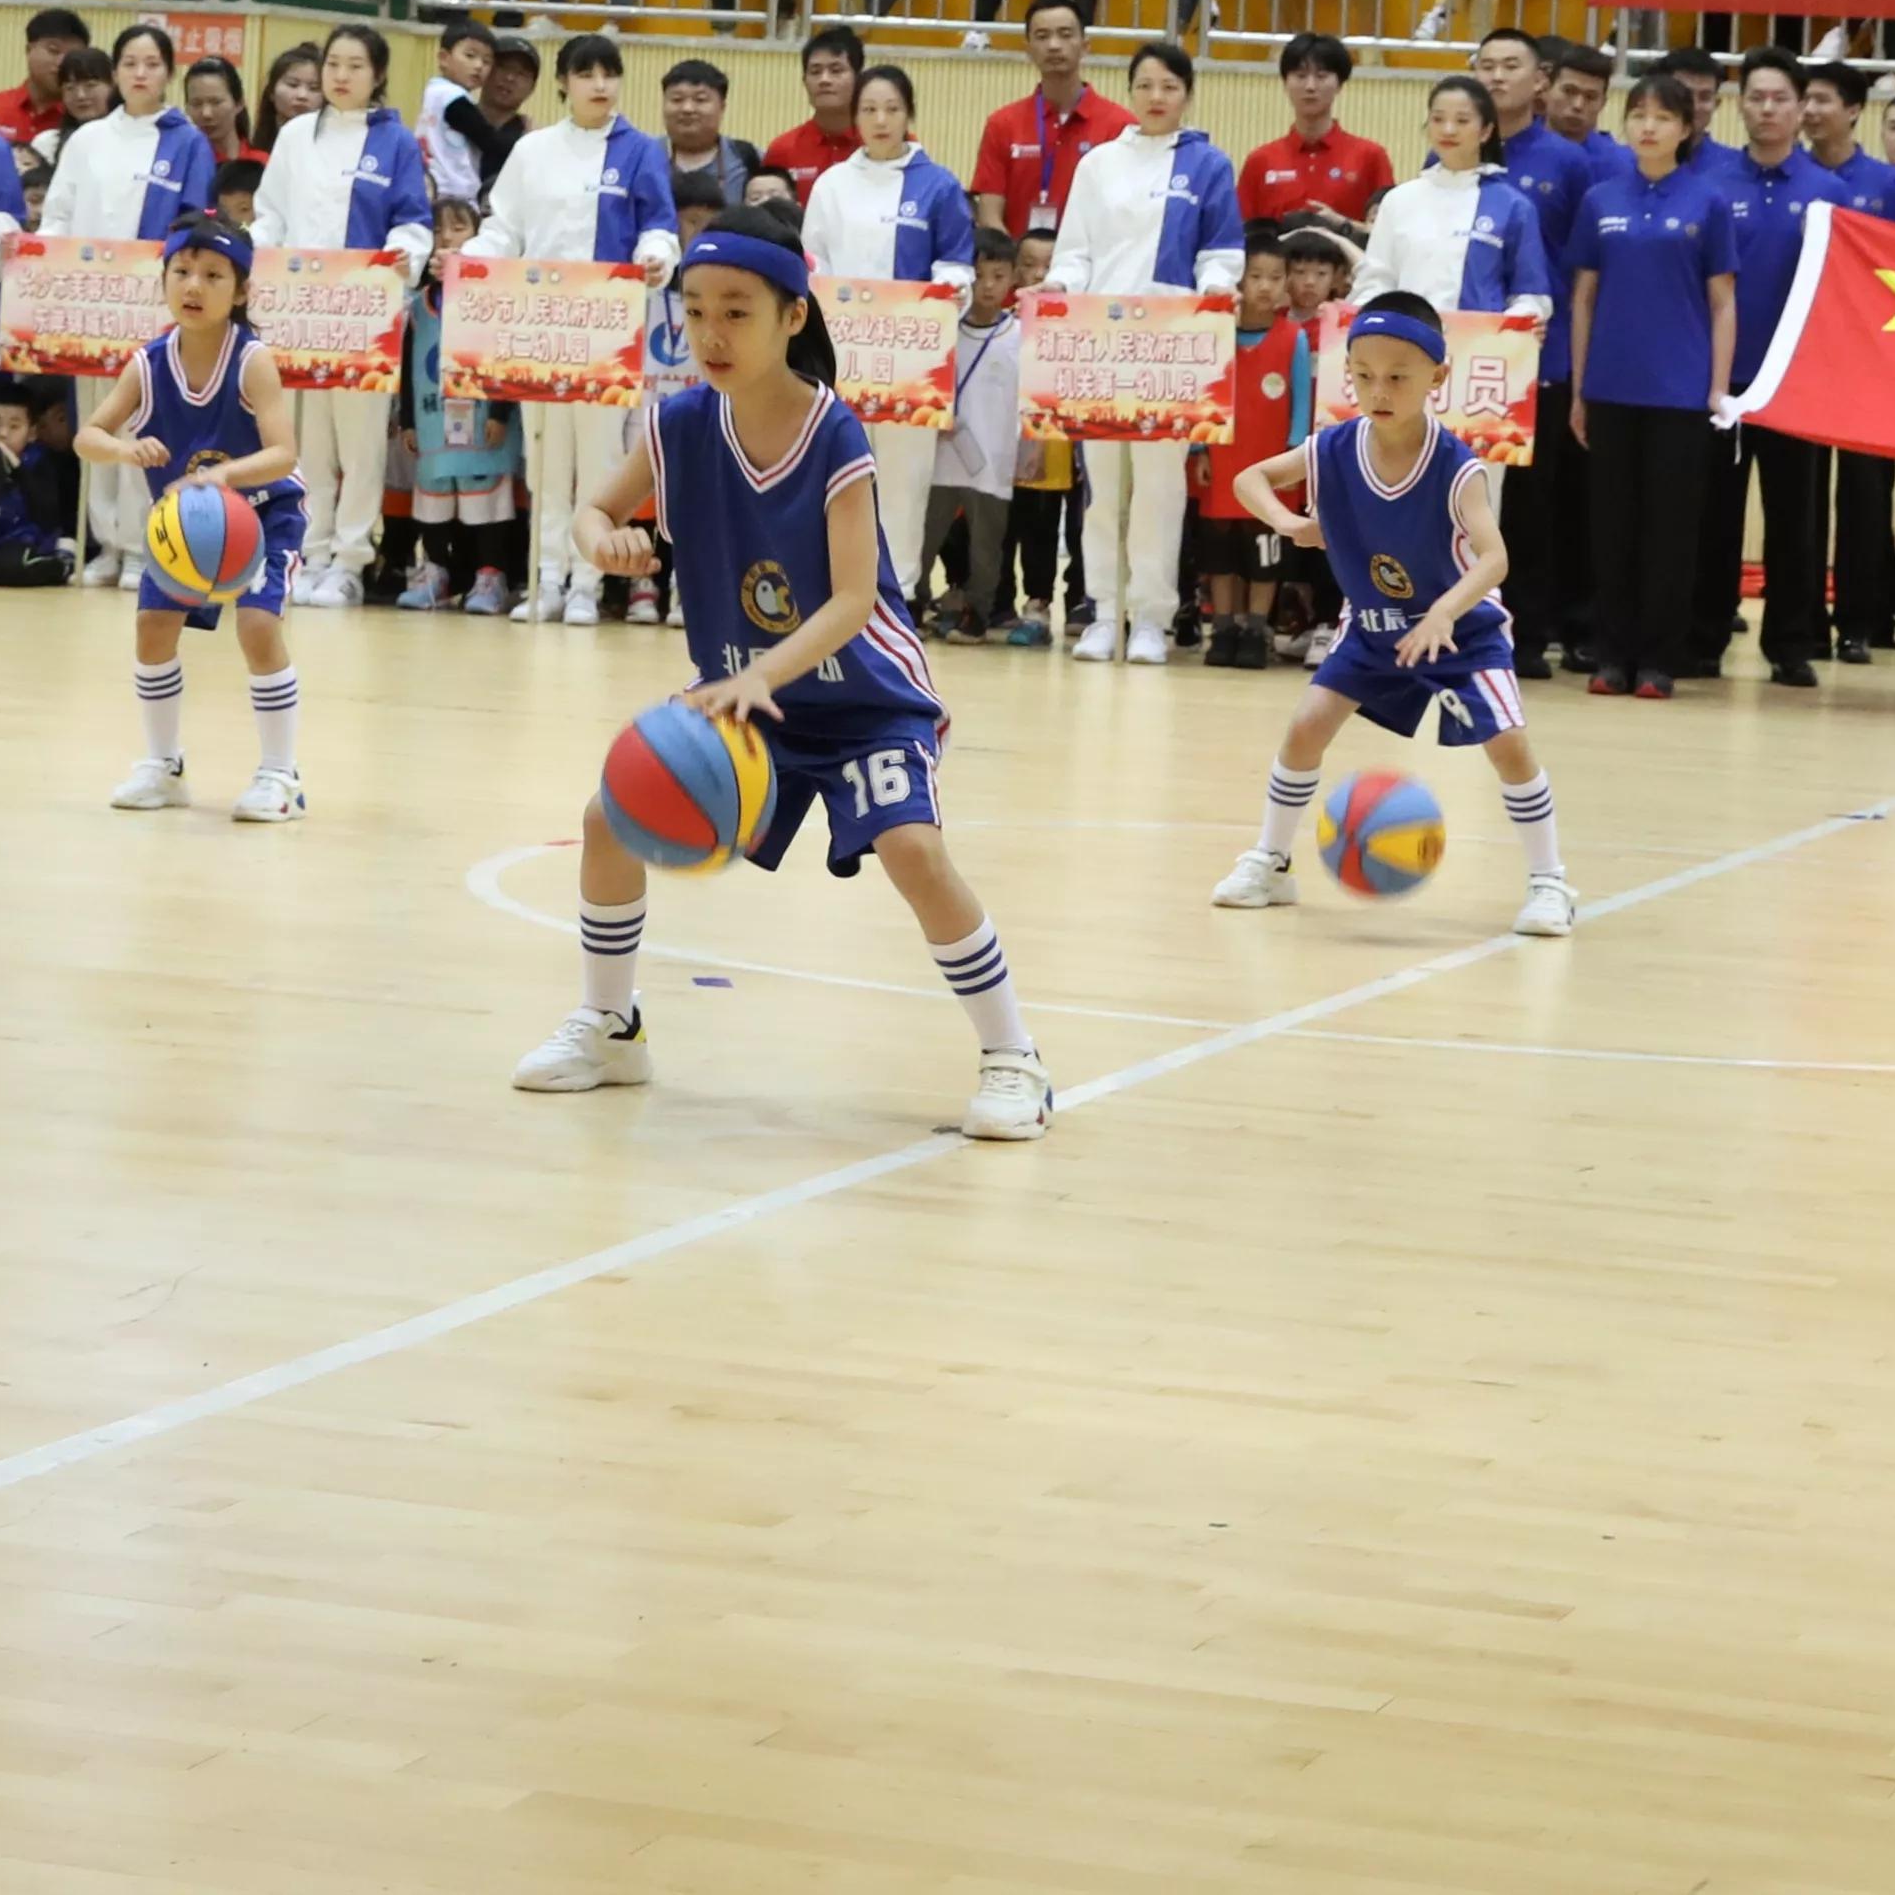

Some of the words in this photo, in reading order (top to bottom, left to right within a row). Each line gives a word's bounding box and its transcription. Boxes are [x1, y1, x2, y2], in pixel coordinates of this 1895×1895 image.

[17, 267, 167, 305] 长沙市芙蓉区教育
[458, 289, 629, 330] 长沙市人民政府机关
[495, 331, 590, 365] 第二幼儿园
[823, 313, 943, 351] 农业科学院
[1036, 329, 1218, 365] 湖南省人民政府直属
[1357, 606, 1429, 633] 北辰一
[841, 749, 911, 819] 16
